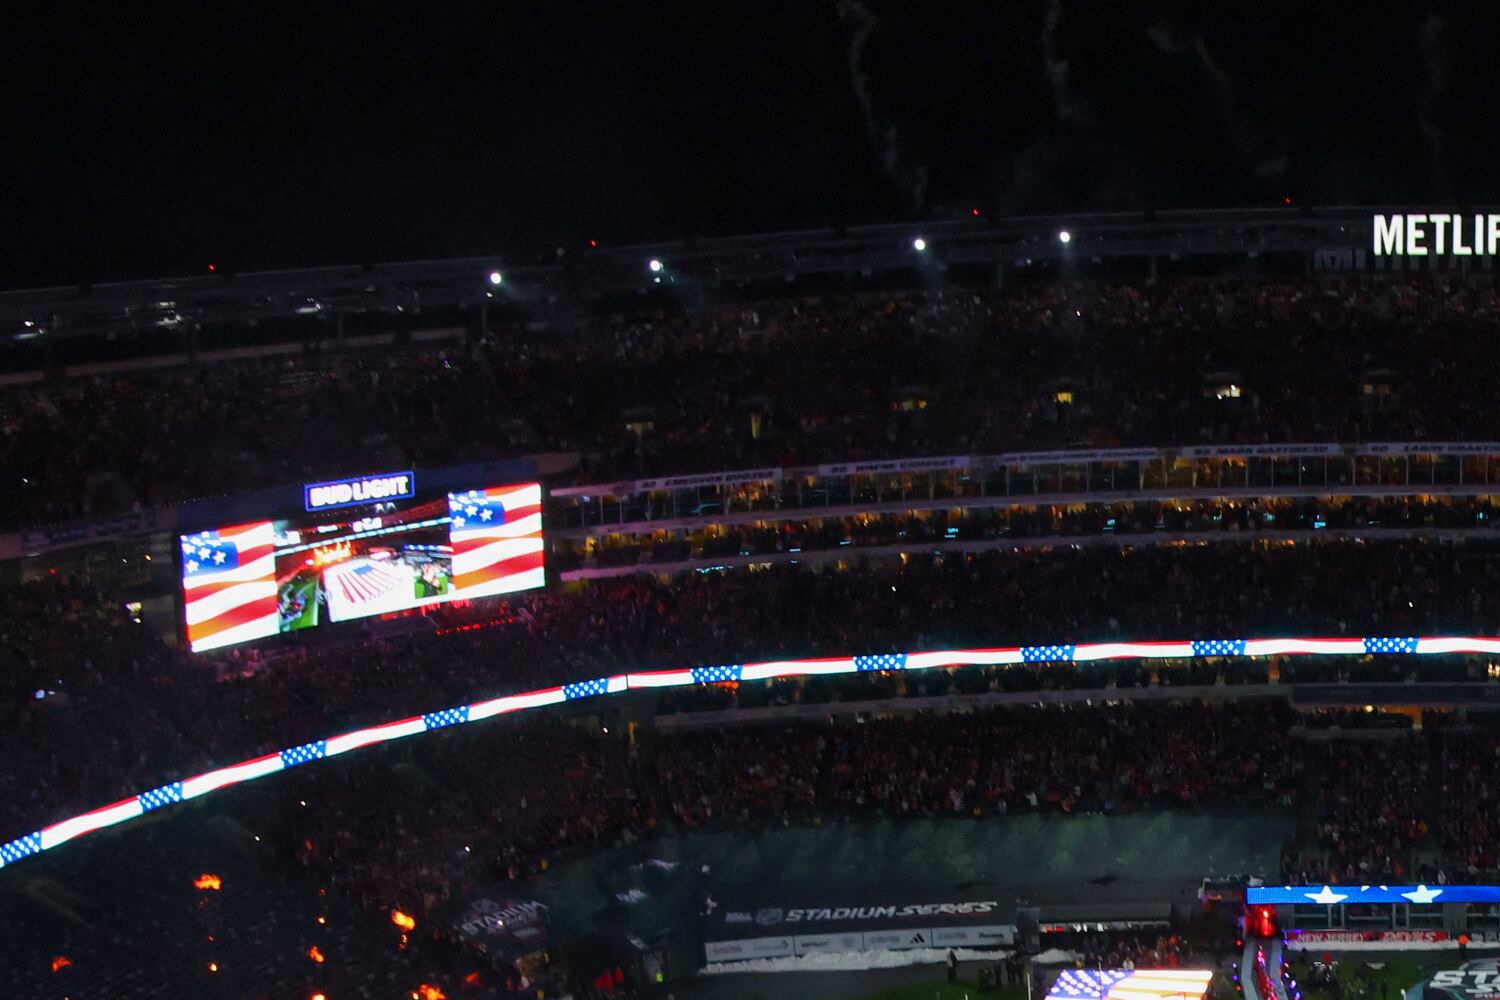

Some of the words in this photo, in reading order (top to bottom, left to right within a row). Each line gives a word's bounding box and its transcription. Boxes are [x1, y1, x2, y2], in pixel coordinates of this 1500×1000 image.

[310, 484, 353, 507] BUD
[353, 475, 409, 501] LIGHT
[785, 906, 897, 922] STADIUM
[896, 901, 998, 917] SERIES
